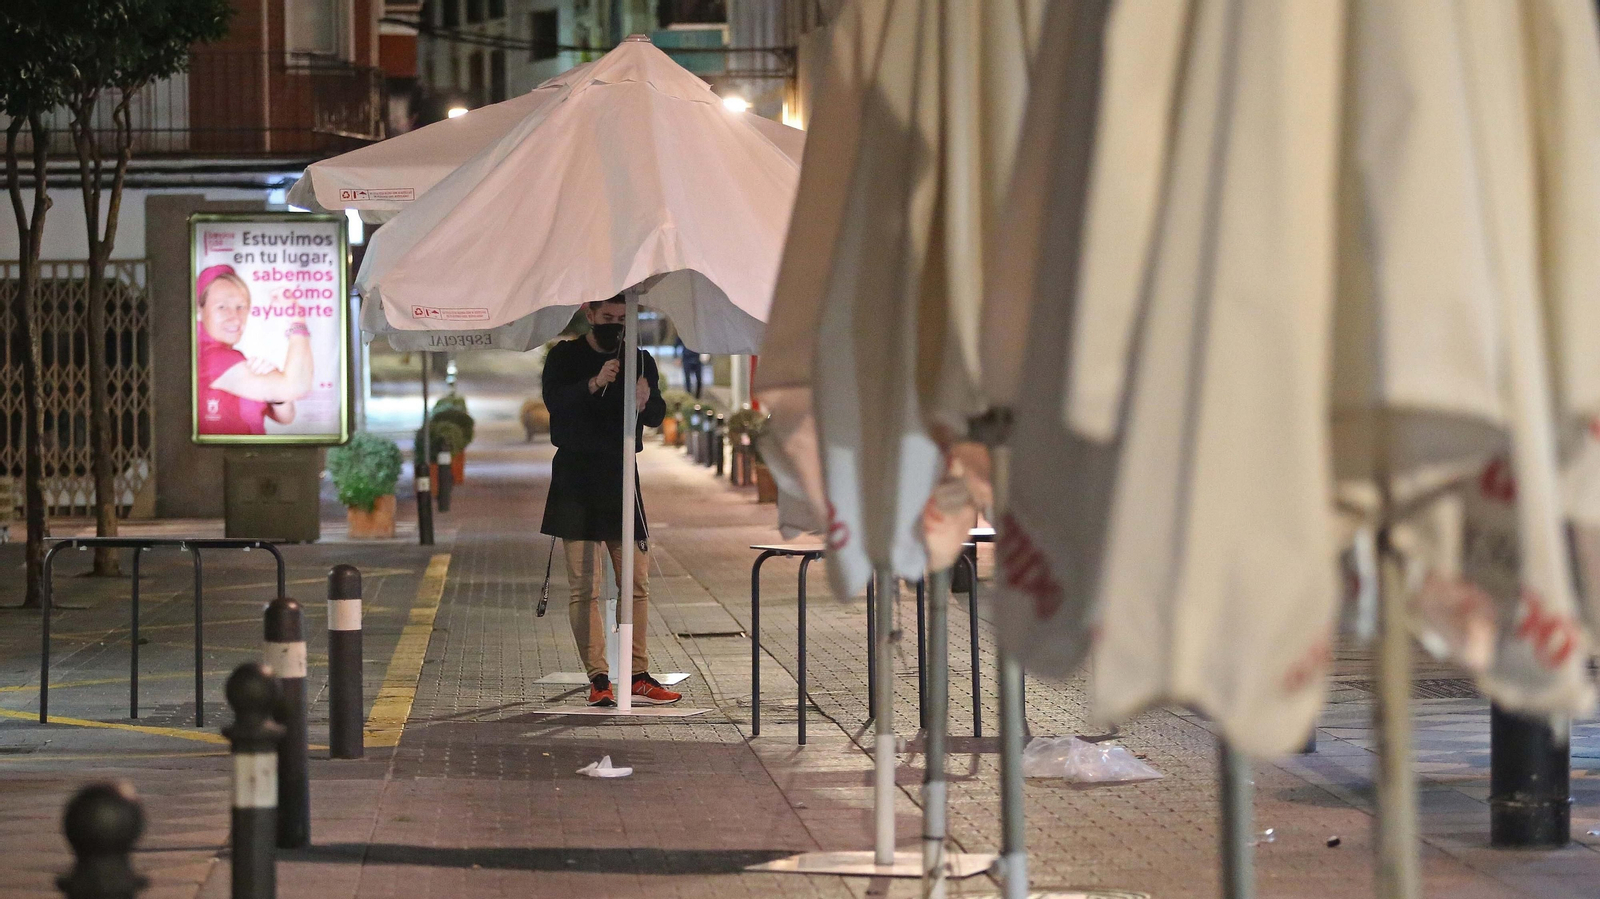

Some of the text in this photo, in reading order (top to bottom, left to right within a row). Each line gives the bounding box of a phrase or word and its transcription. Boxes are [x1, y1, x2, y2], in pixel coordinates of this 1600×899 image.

[242, 231, 333, 246] Estuvimos
[233, 249, 333, 267] en tu lugar,
[252, 267, 333, 282] sabemos
[282, 285, 333, 300] cómo
[251, 304, 333, 320] ayudarte
